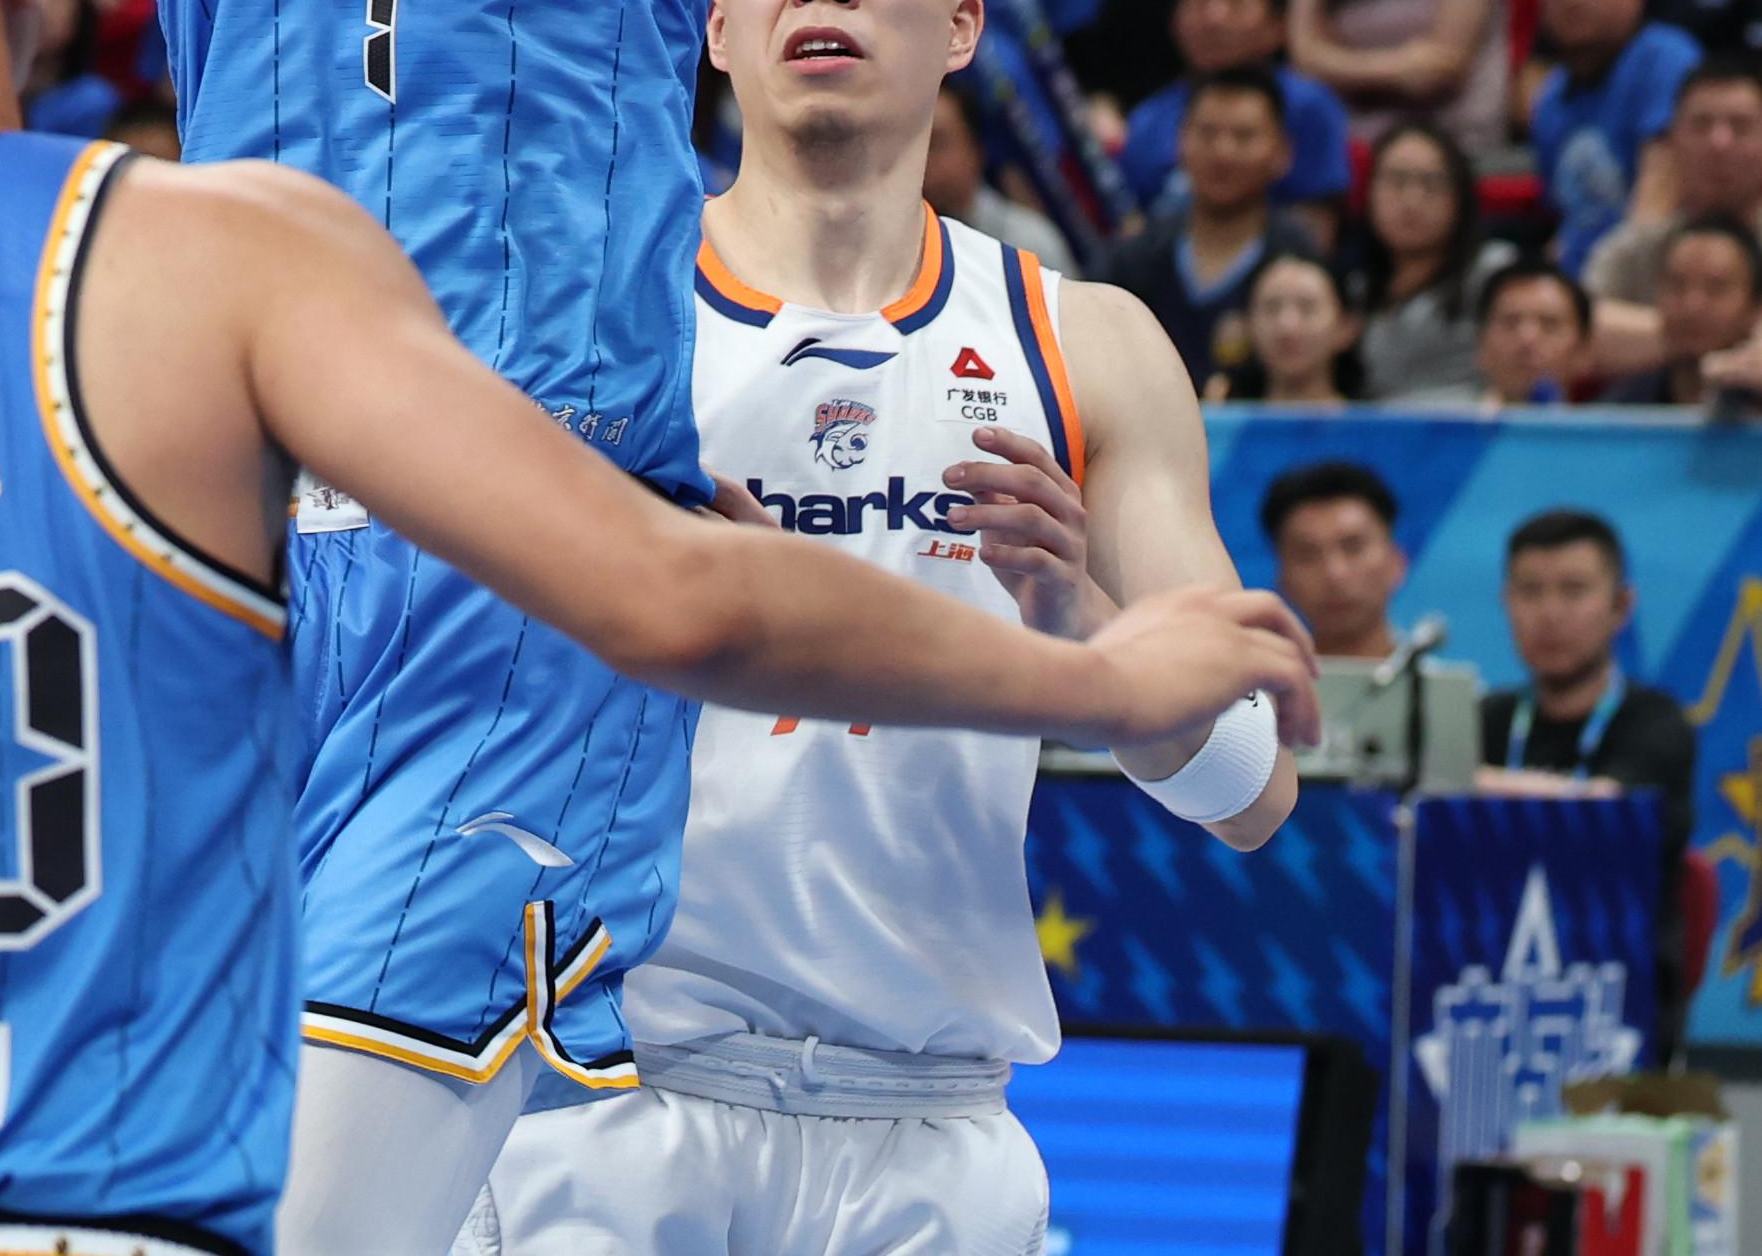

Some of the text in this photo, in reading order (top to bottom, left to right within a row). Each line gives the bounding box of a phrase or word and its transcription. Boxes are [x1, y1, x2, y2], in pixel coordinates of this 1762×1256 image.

[947, 388, 1007, 406] 广发银行
[961, 405, 998, 422] CGB
[746, 476, 976, 535] harks
[917, 540, 976, 562] 上海
